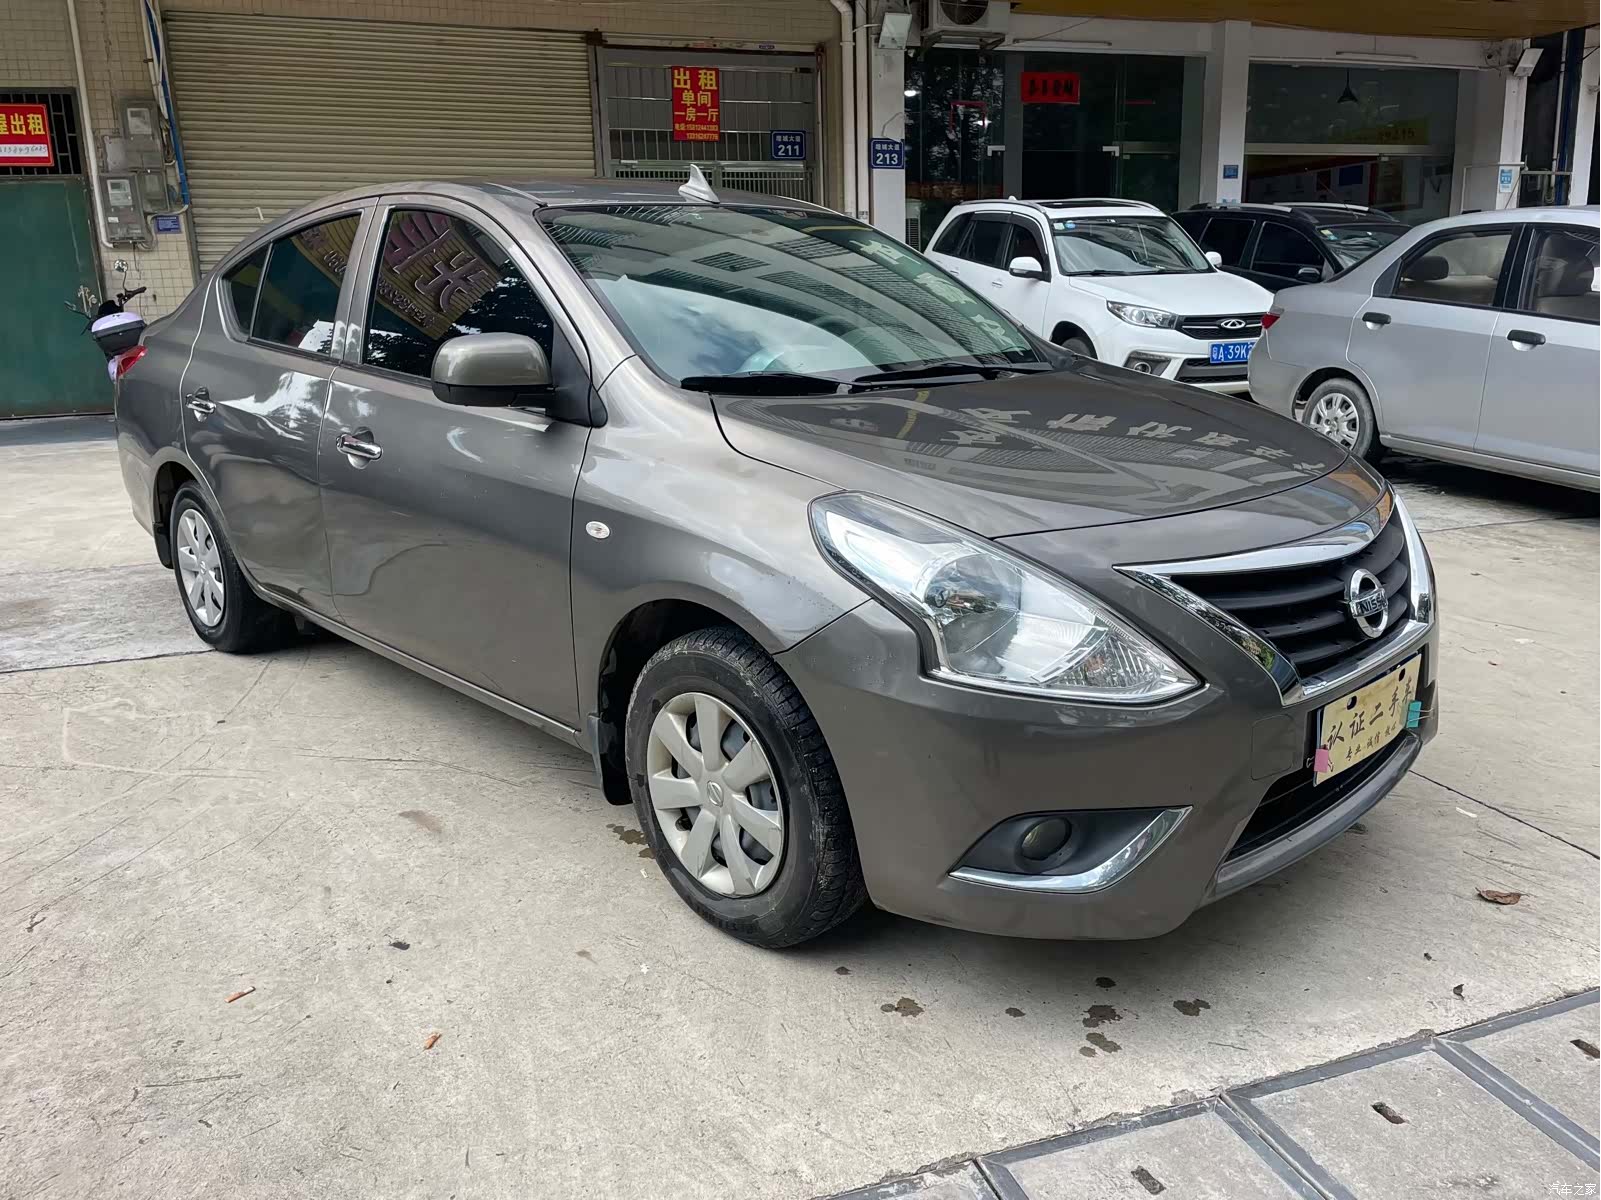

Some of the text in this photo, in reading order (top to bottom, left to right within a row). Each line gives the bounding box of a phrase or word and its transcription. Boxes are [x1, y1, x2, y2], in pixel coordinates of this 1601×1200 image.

[673, 68, 718, 90] 出租
[681, 90, 711, 107] 单间
[674, 107, 719, 122] 一房一厅
[777, 144, 800, 156] 211
[876, 153, 899, 165] 213
[1327, 676, 1411, 751] 认证二手车
